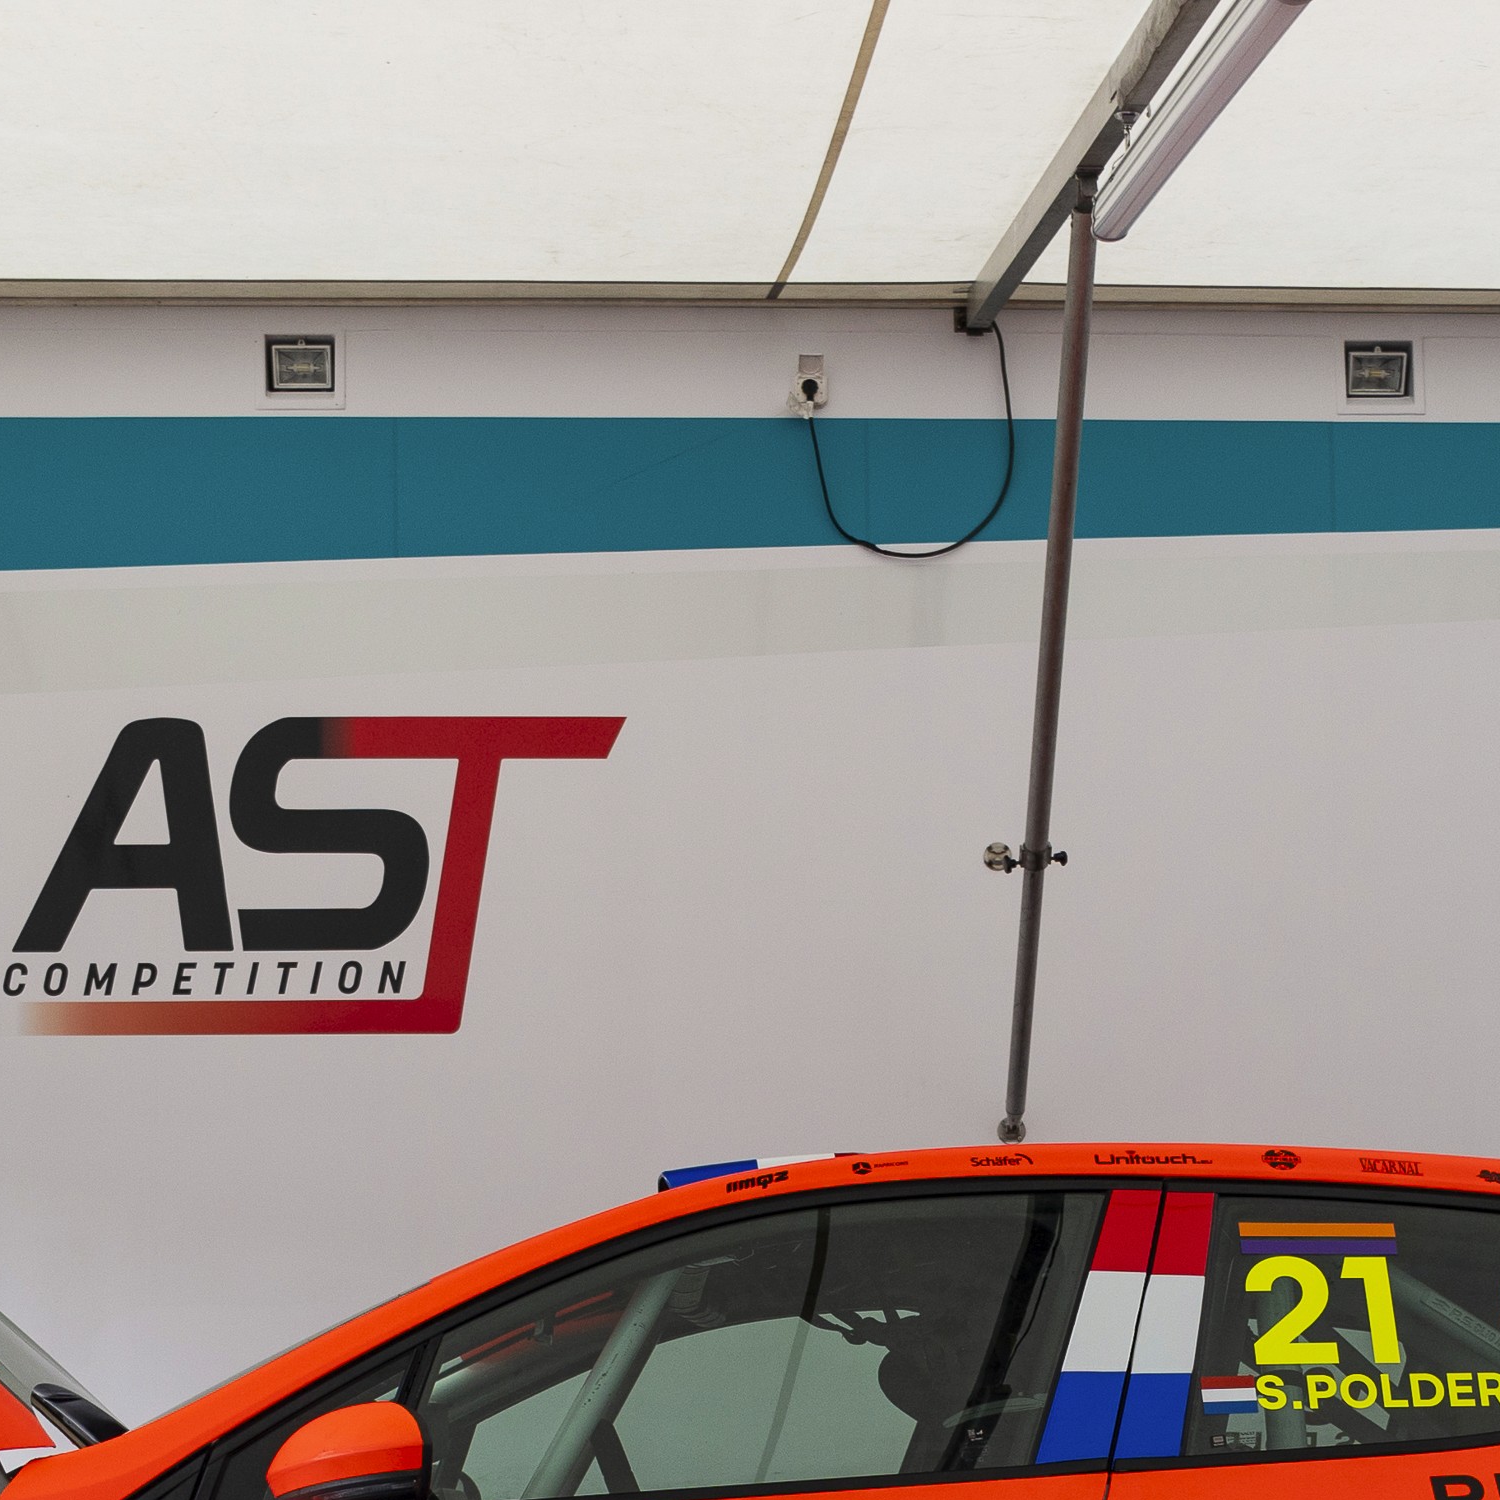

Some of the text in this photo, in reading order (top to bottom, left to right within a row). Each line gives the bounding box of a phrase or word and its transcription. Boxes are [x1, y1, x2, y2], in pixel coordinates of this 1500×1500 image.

[12, 716, 627, 1034] AST
[3, 961, 406, 997] COMPETITION
[1245, 1255, 1402, 1366] 21
